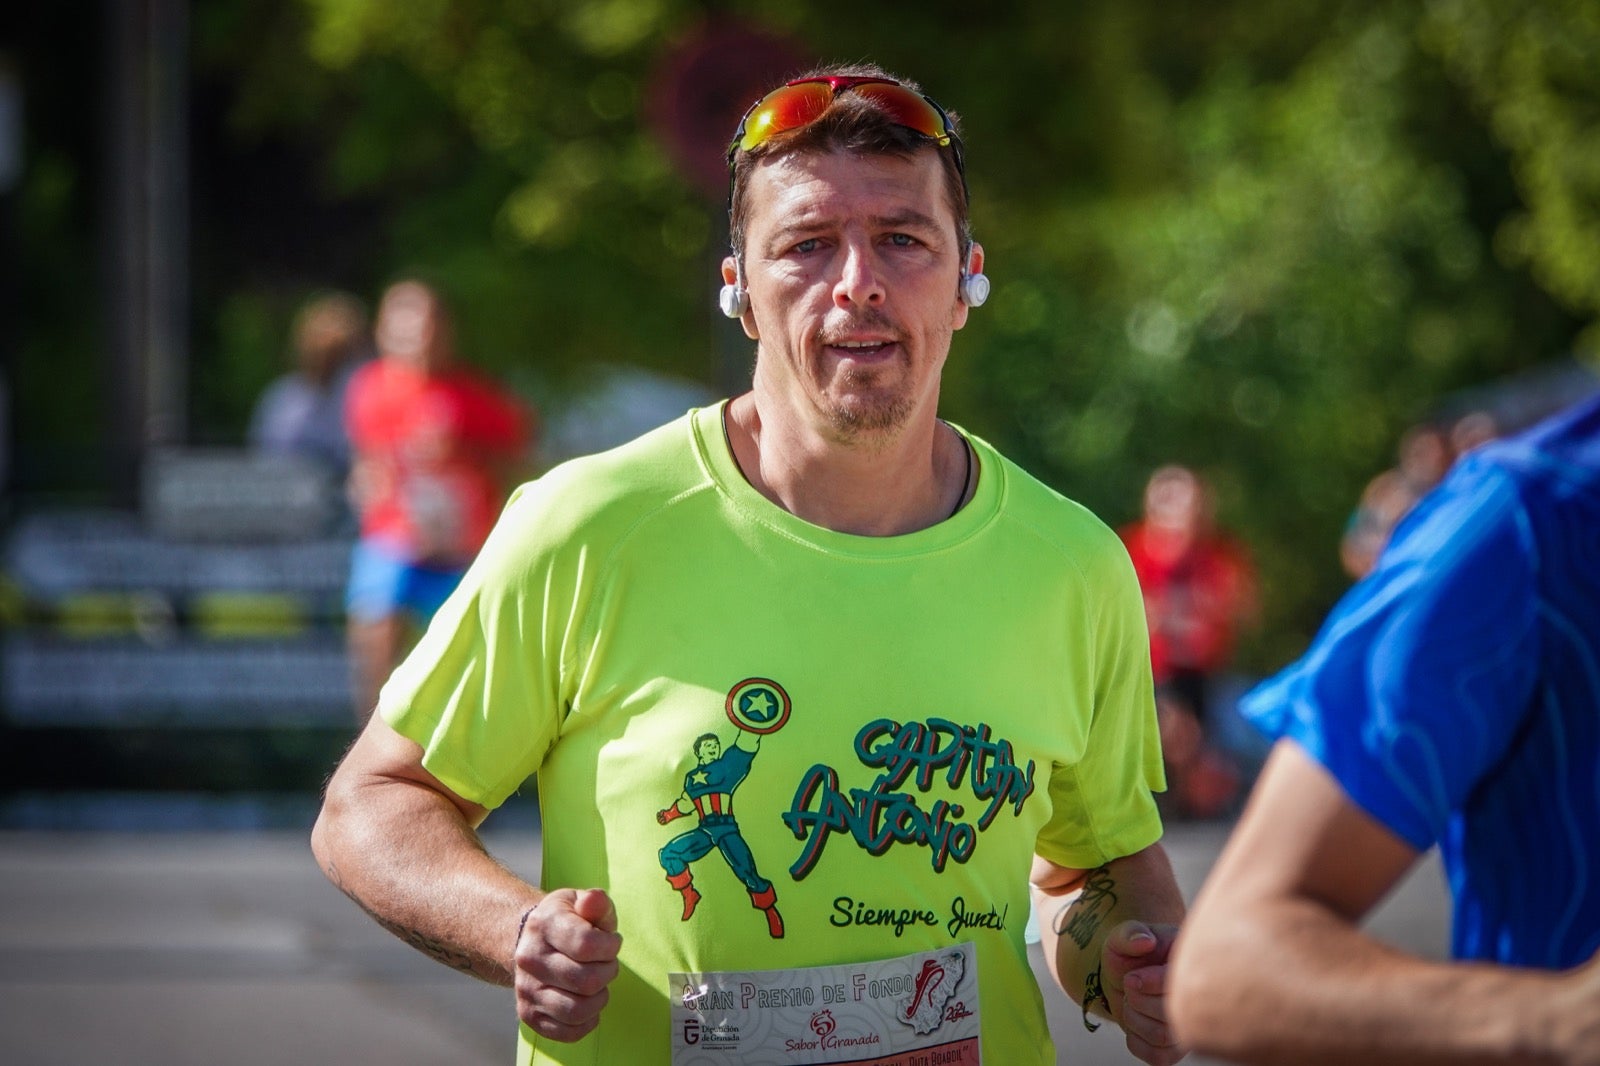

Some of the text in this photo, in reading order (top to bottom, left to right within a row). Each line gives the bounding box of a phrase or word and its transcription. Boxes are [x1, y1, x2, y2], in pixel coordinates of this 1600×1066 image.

[829, 896, 939, 938] Siempre
[682, 973, 913, 1011] GRAN PREMIO DE FONDO
[701, 1024, 739, 1033] Dipación
[710, 1033, 740, 1041] Granada
[785, 1032, 880, 1051] Sabor Granada
